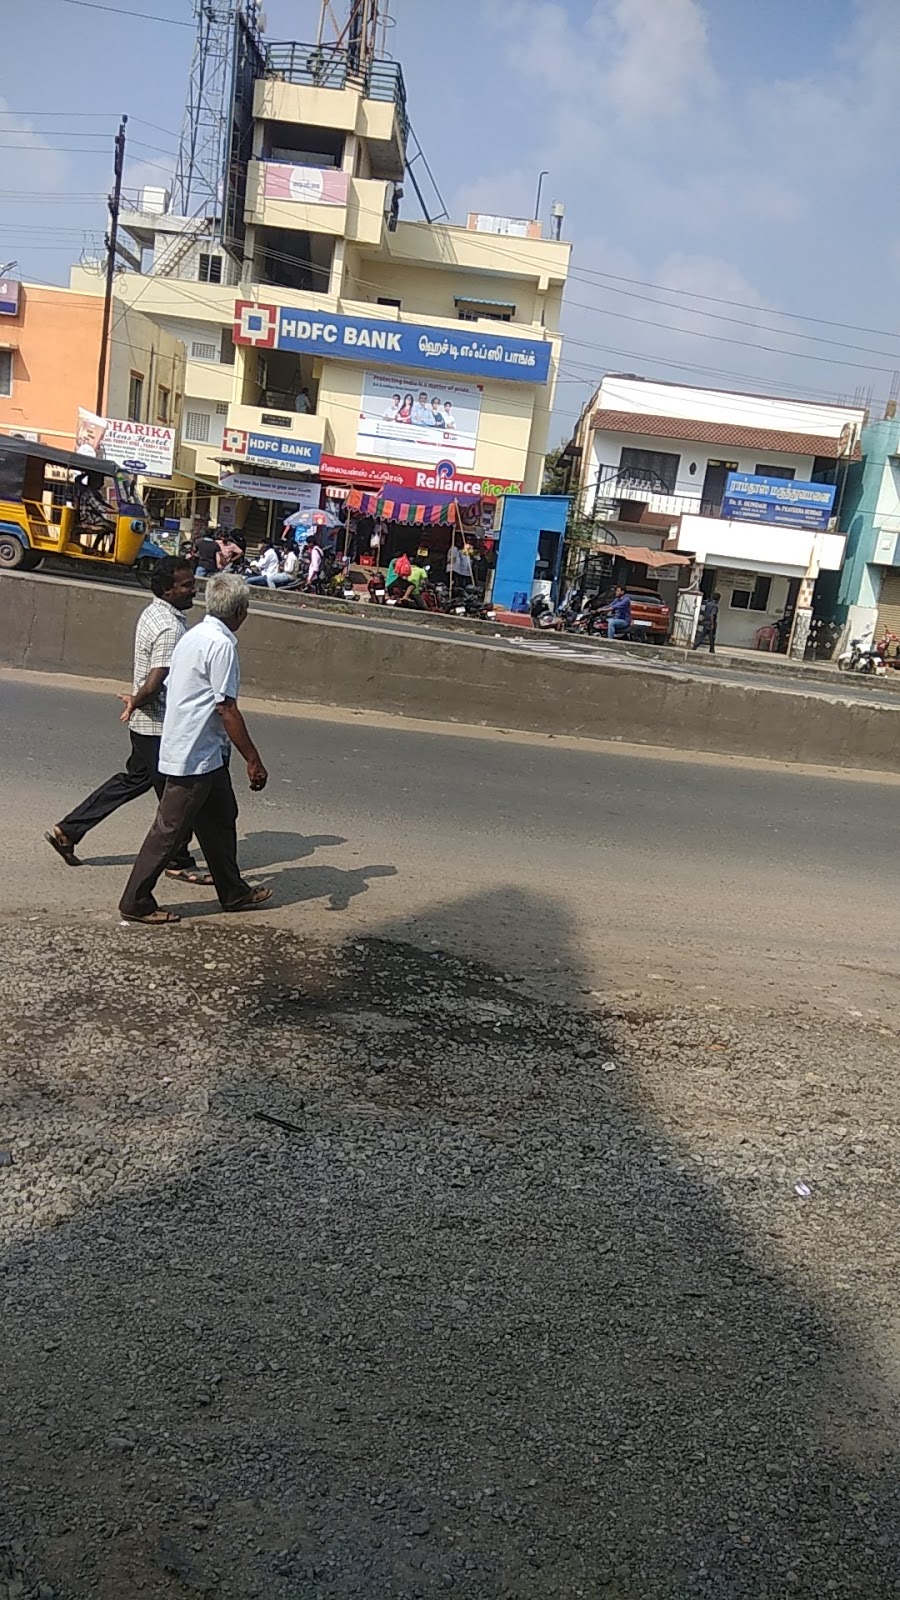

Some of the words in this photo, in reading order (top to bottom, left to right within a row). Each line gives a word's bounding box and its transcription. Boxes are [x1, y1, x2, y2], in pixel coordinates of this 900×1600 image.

[281, 319, 338, 343] HDFC
[343, 327, 403, 353] BANK
[504, 349, 536, 366] பாங்க்
[137, 435, 168, 446] Hostel
[249, 438, 279, 452] HDFC
[281, 443, 312, 457] BANK
[415, 472, 481, 495] Reliance
